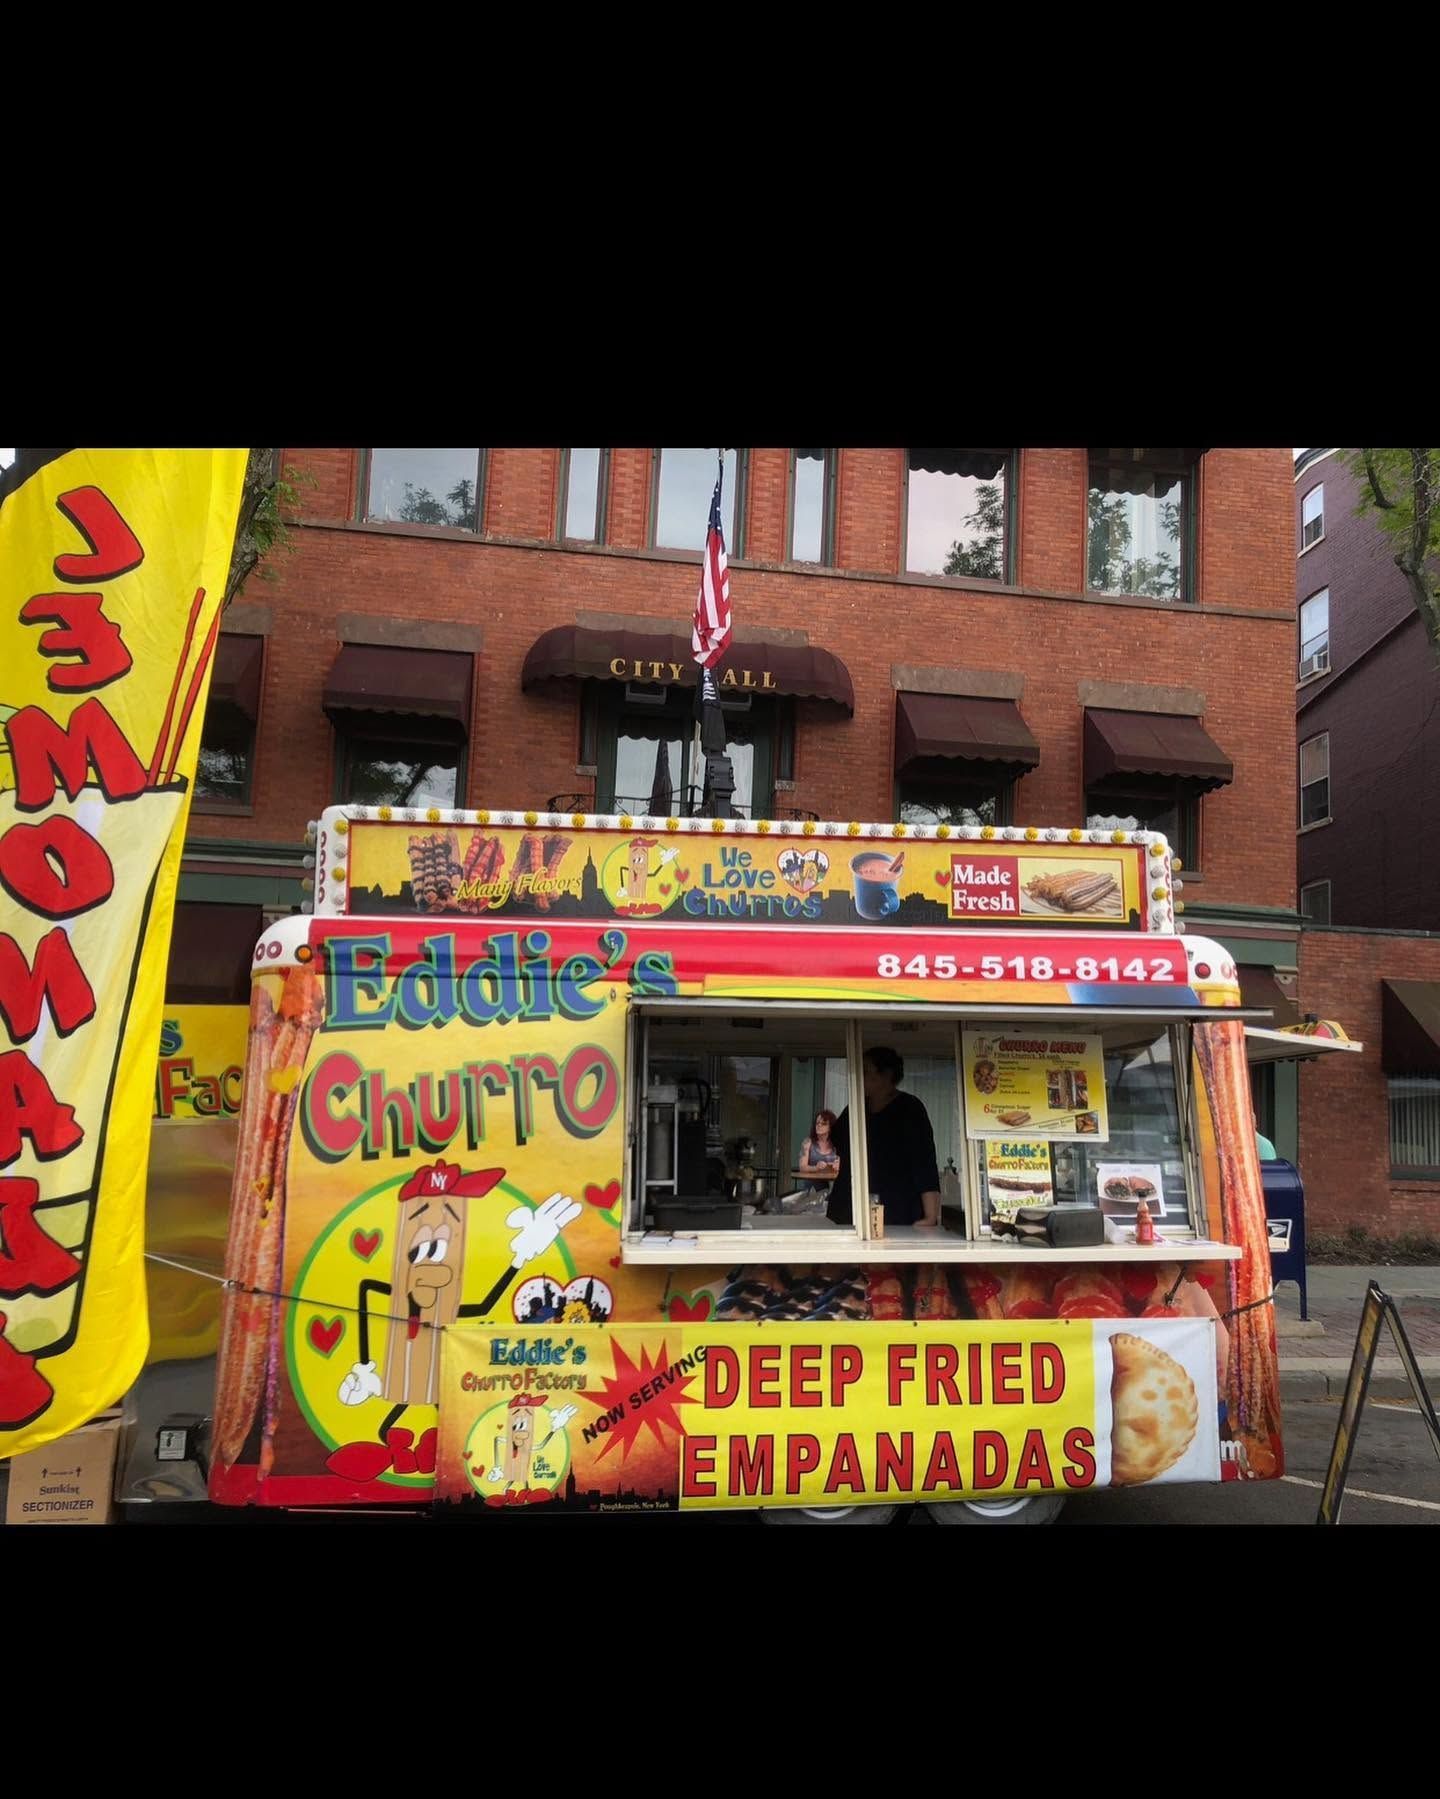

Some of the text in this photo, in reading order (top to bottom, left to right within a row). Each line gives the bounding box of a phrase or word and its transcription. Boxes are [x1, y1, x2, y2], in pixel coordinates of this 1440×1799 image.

[610, 658, 776, 689] CITY ALL
[719, 846, 753, 868] We
[456, 866, 582, 909] Many Flavors
[703, 863, 776, 890] Love
[952, 863, 1012, 886] Made
[683, 887, 824, 919] Churros
[952, 889, 1016, 913] Fresh
[320, 929, 680, 1032] Eddie's
[877, 953, 1175, 982] 845-518-8142
[301, 1043, 622, 1164] Churro
[1000, 1143, 1047, 1157] Eddie's
[430, 1171, 448, 1190] NY
[488, 1337, 588, 1366] Eddie's
[704, 1341, 1067, 1409] DEEP FRIED
[581, 1345, 709, 1444] NOW SERVING
[681, 1426, 1098, 1499] EMPANADAS
[39, 1483, 81, 1496] Sunkist
[22, 1499, 95, 1513] SECTIONIZER
